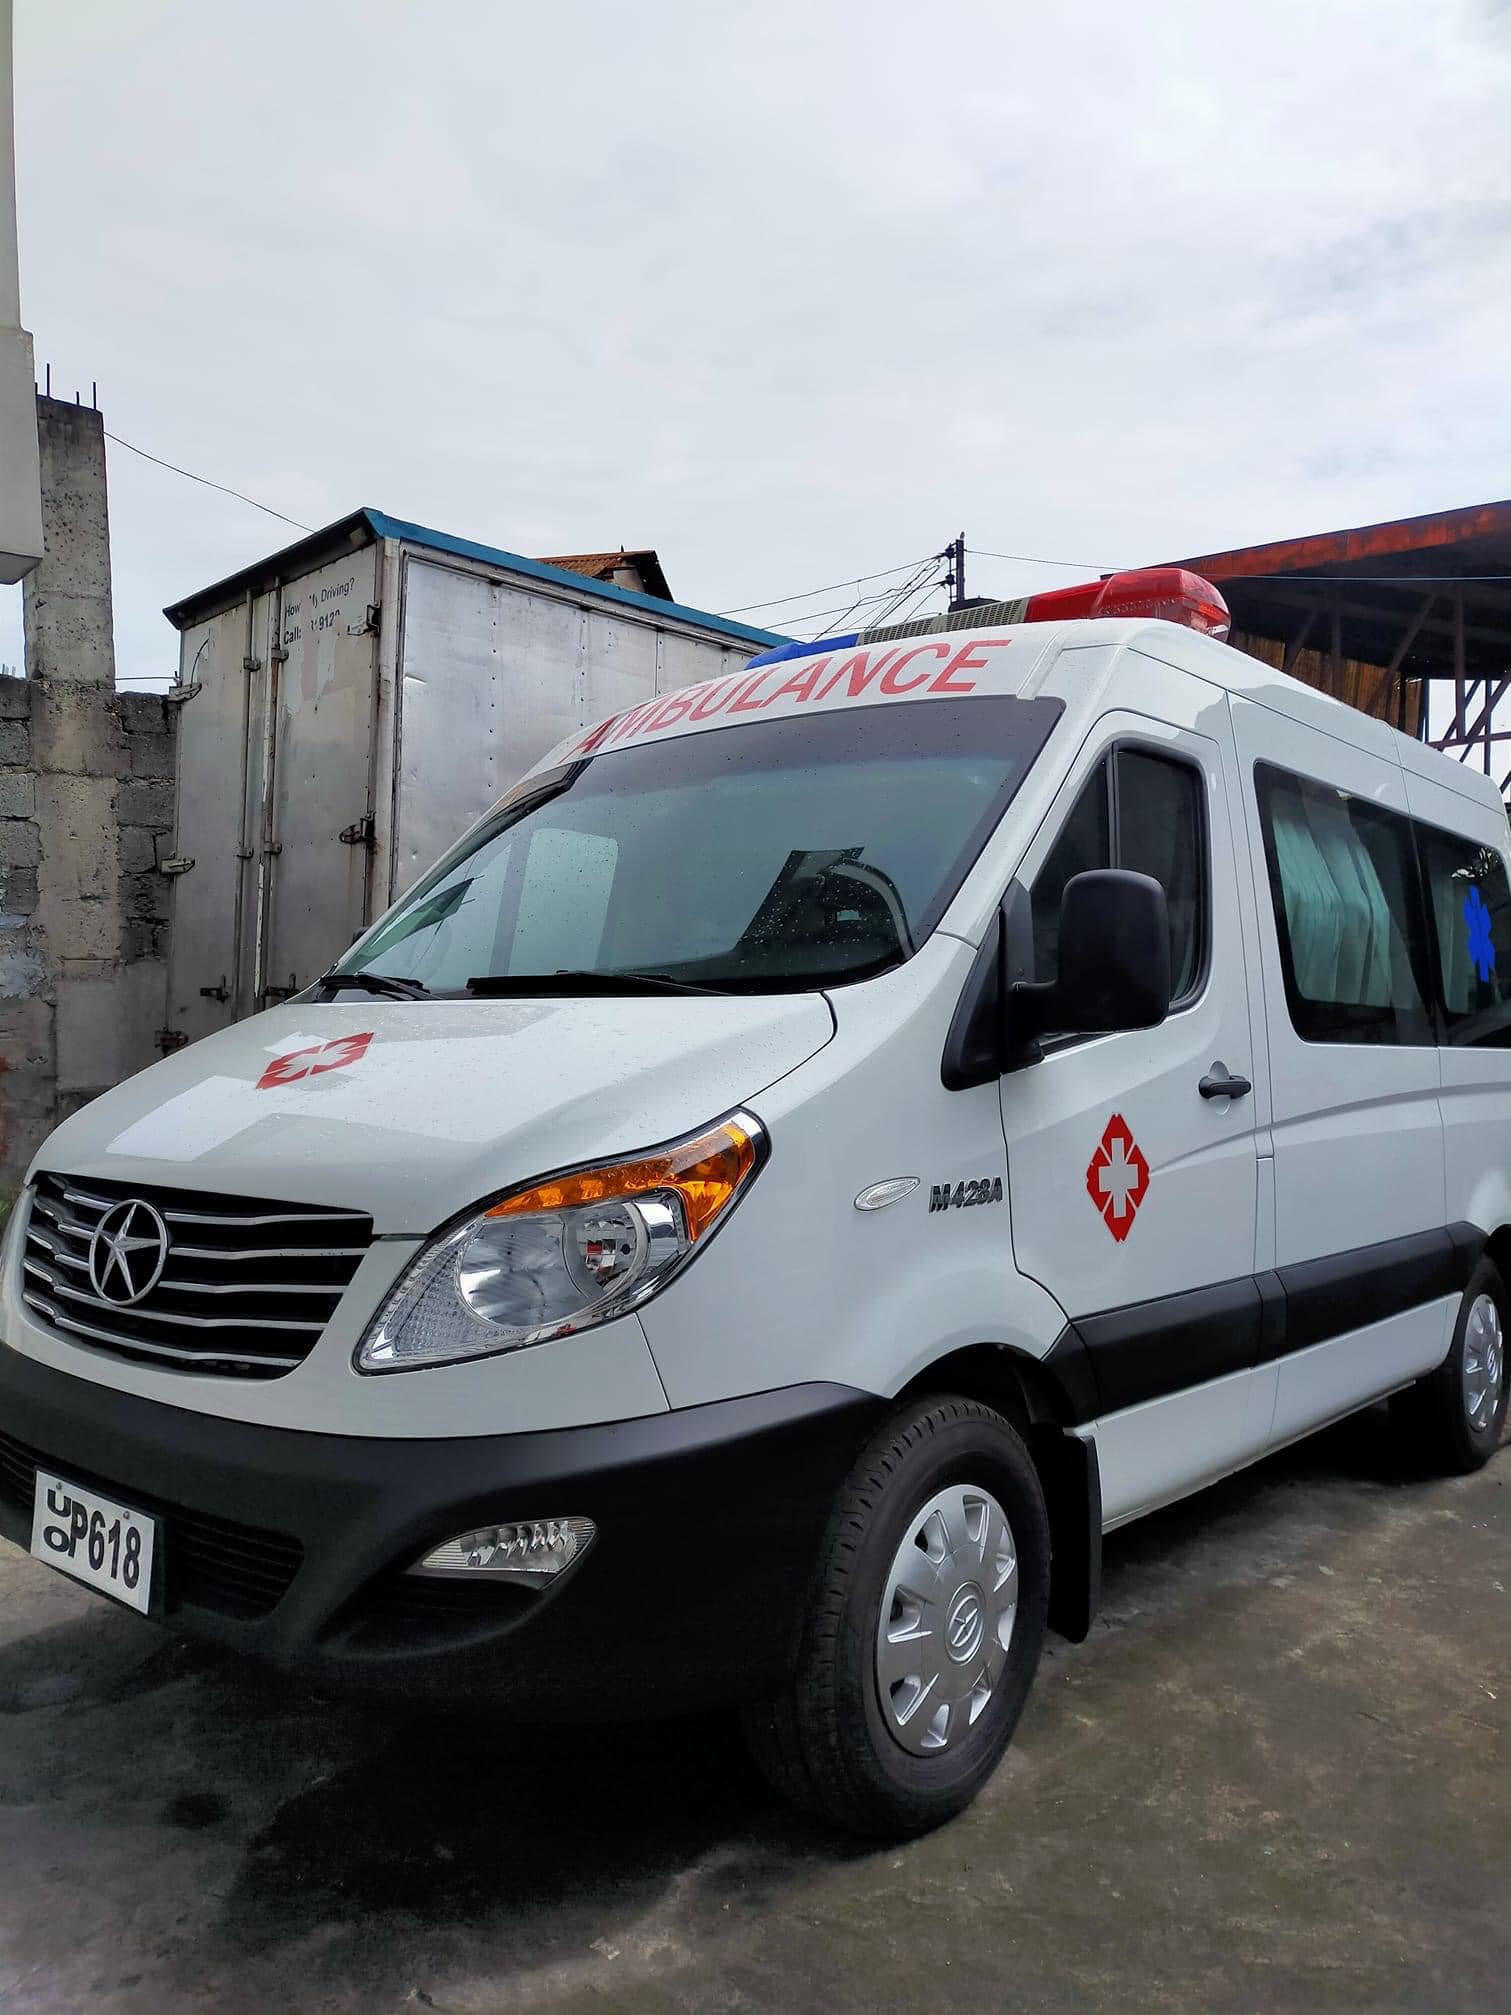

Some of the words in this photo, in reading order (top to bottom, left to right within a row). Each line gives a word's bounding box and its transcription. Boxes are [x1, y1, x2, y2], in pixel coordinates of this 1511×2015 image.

[321, 577, 355, 602] Driving?
[283, 626, 302, 646] Call:
[559, 639, 1012, 764] AMBULANCE
[928, 1177, 1003, 1214] M428A
